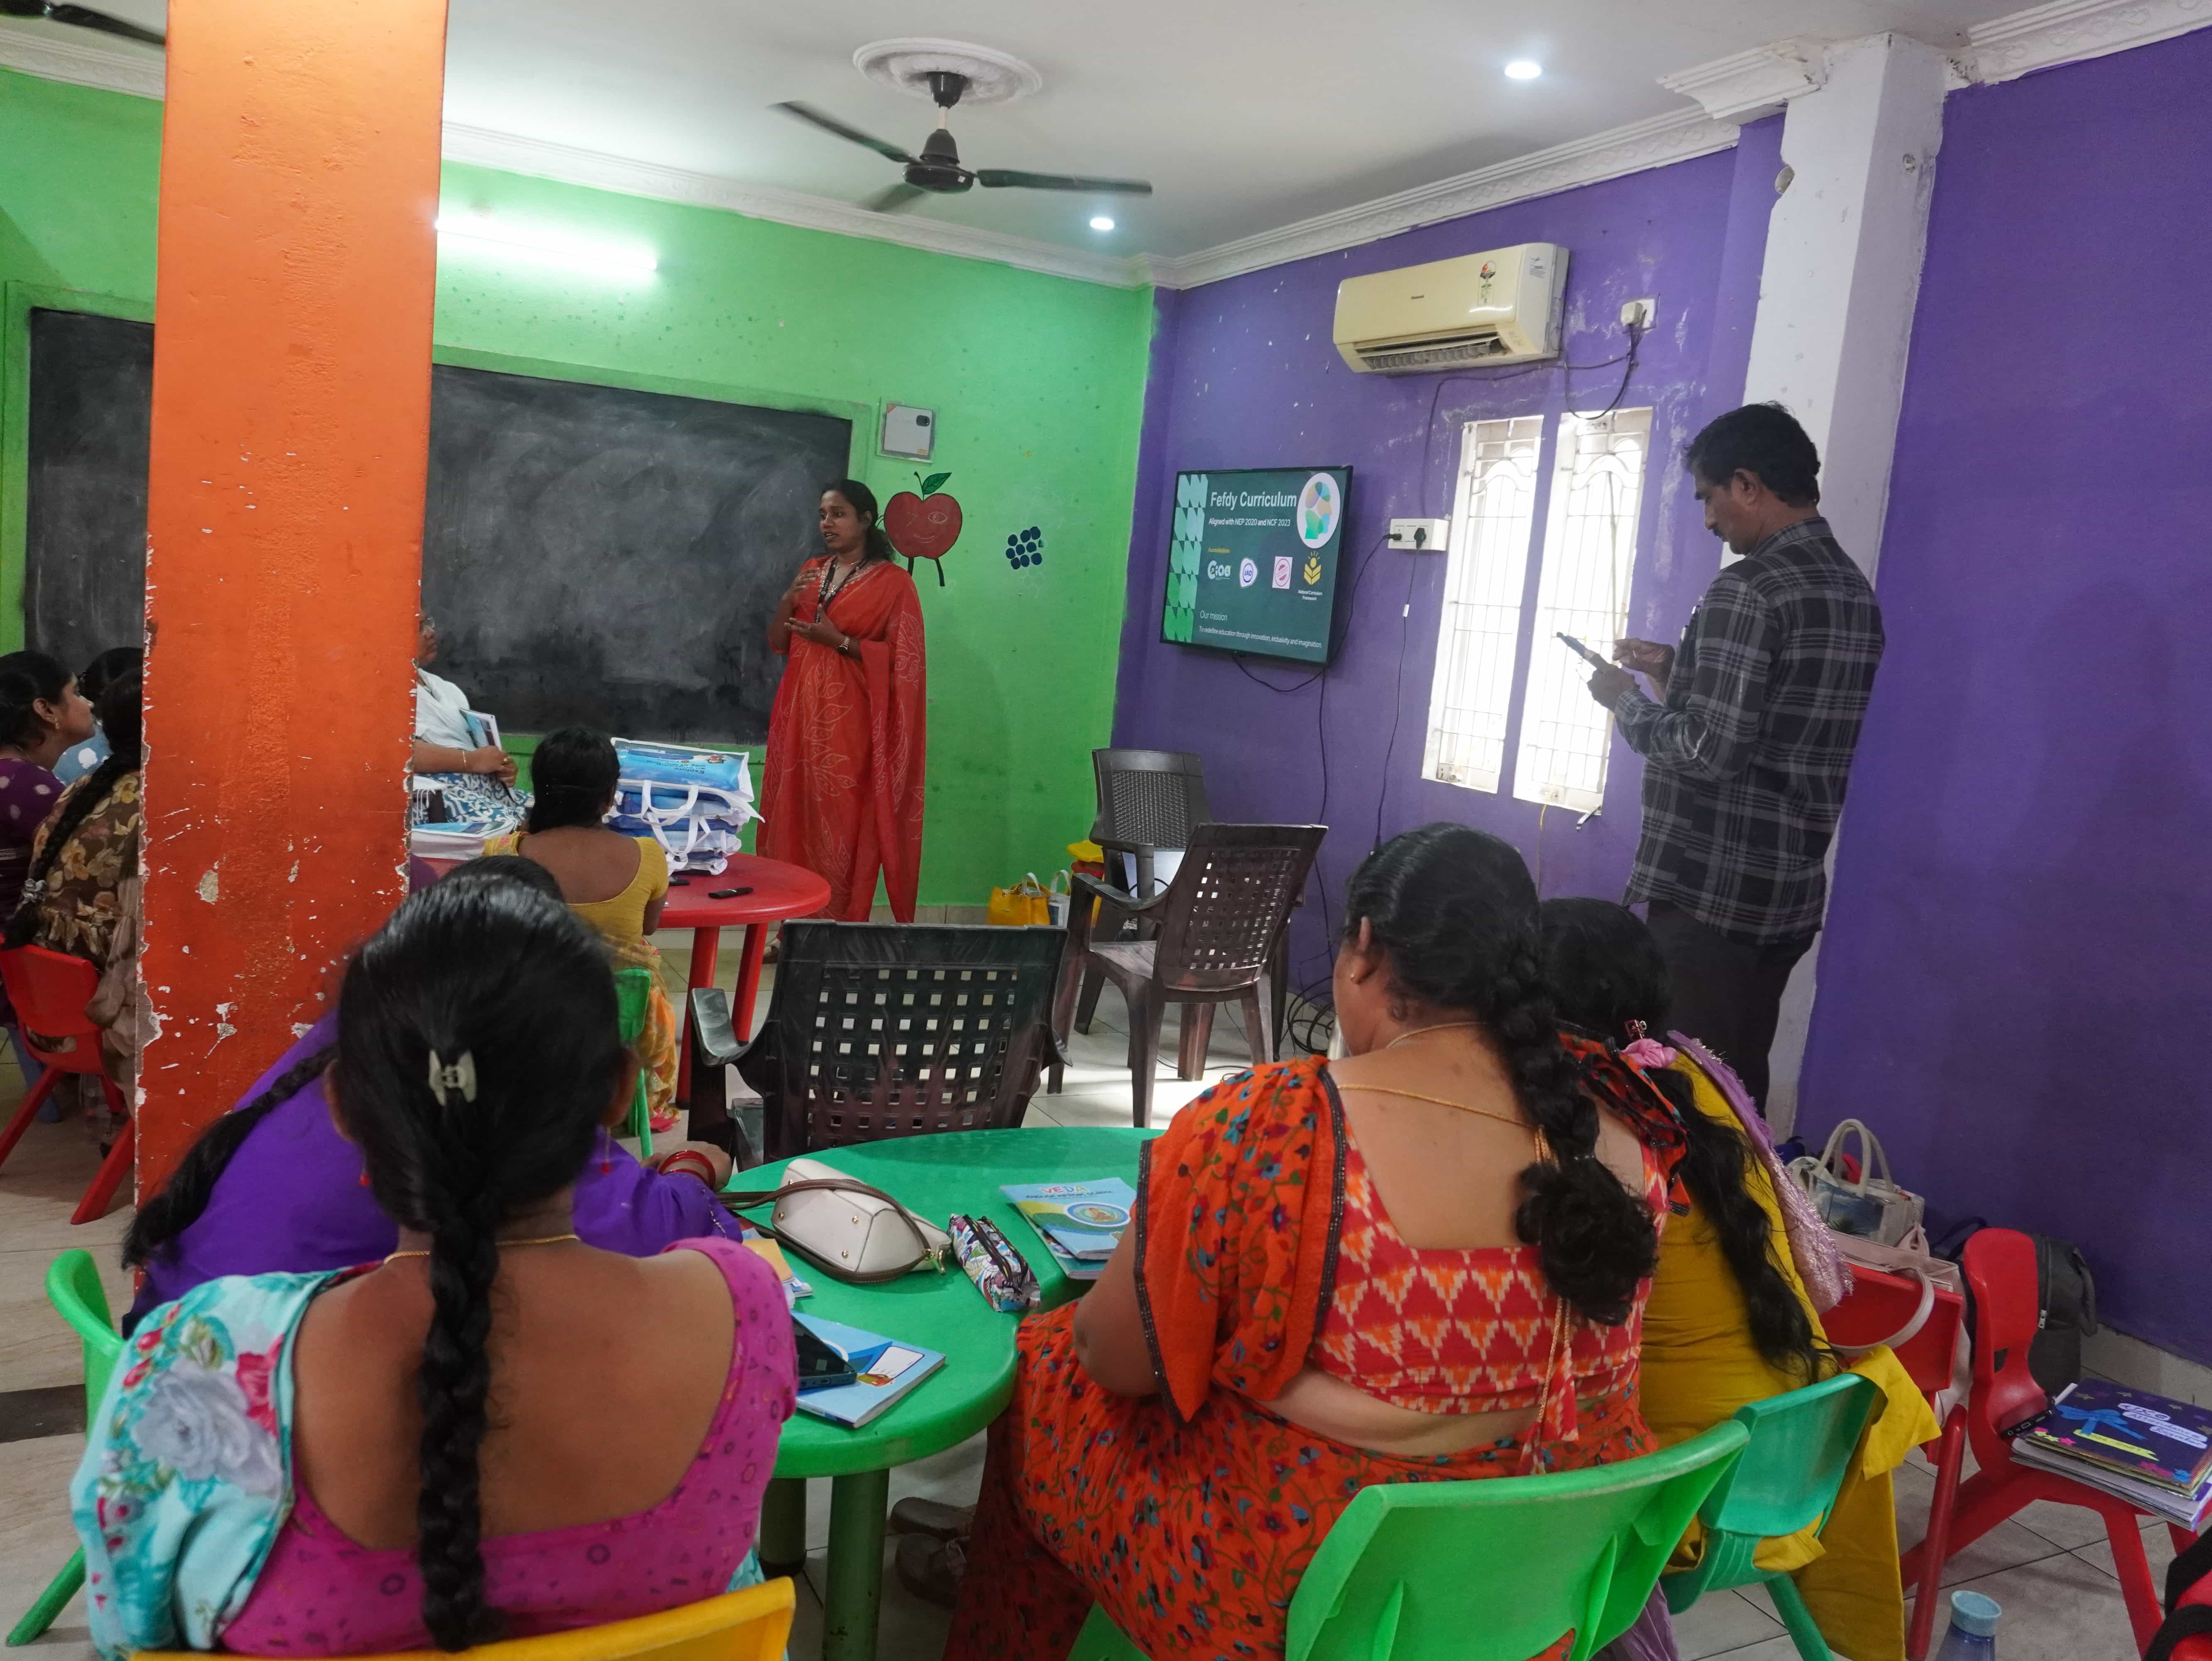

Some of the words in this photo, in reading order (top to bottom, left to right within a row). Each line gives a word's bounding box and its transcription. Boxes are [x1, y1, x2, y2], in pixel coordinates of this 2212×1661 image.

[1210, 492, 1237, 510] Fefdy
[1240, 491, 1297, 507] Curriculum
[1209, 518, 1225, 526] Aligned
[1200, 610, 1209, 619] Our
[1209, 612, 1228, 622] mission
[1236, 631, 1251, 639] through
[1271, 635, 1290, 644] inclusivity
